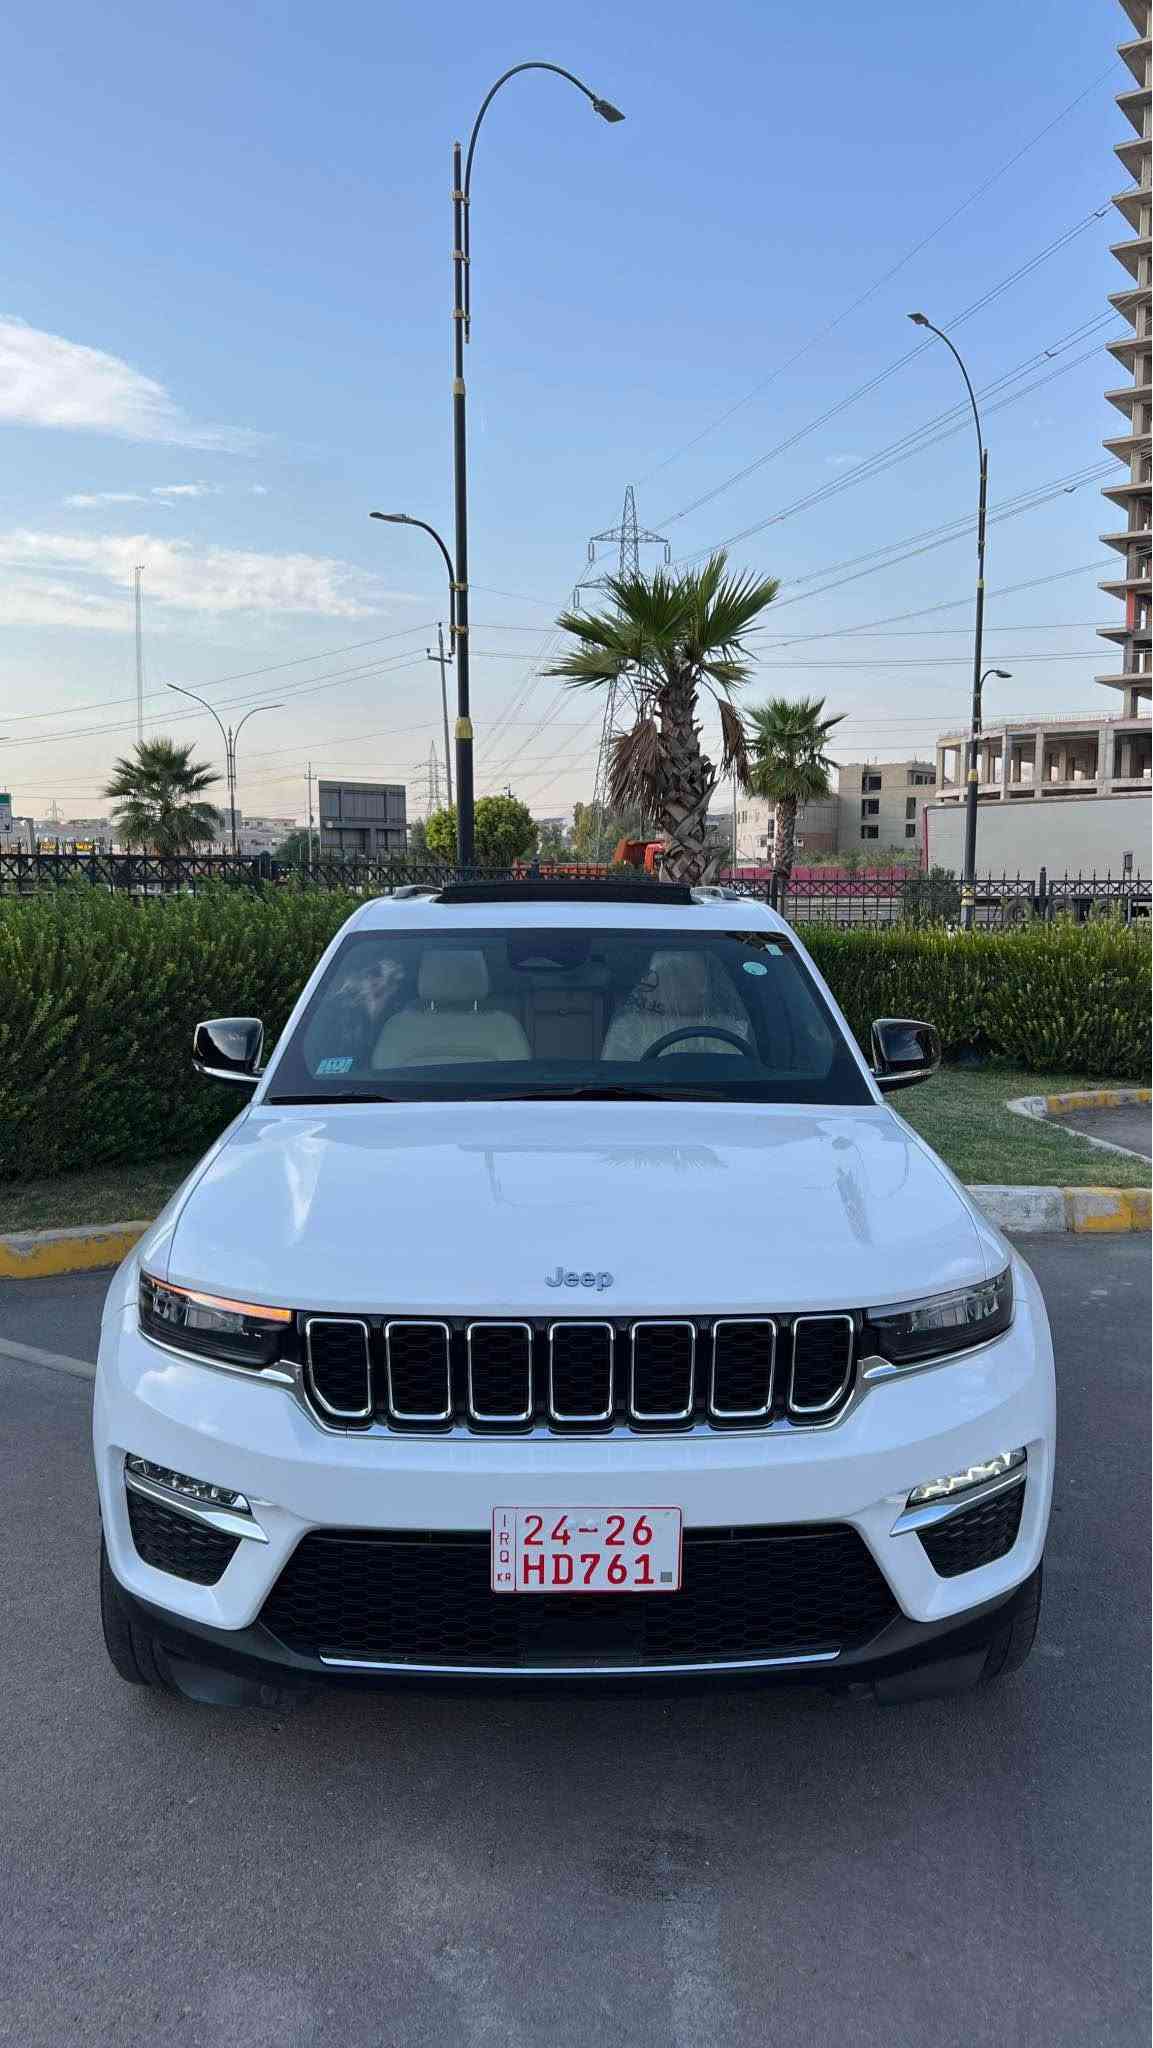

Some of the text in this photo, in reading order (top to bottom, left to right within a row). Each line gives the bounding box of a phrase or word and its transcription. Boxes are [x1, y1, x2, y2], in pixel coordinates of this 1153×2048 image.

[544, 1266, 614, 1292] Jeep
[524, 1515, 653, 1546] 24-26
[523, 1554, 655, 1585] HD761
